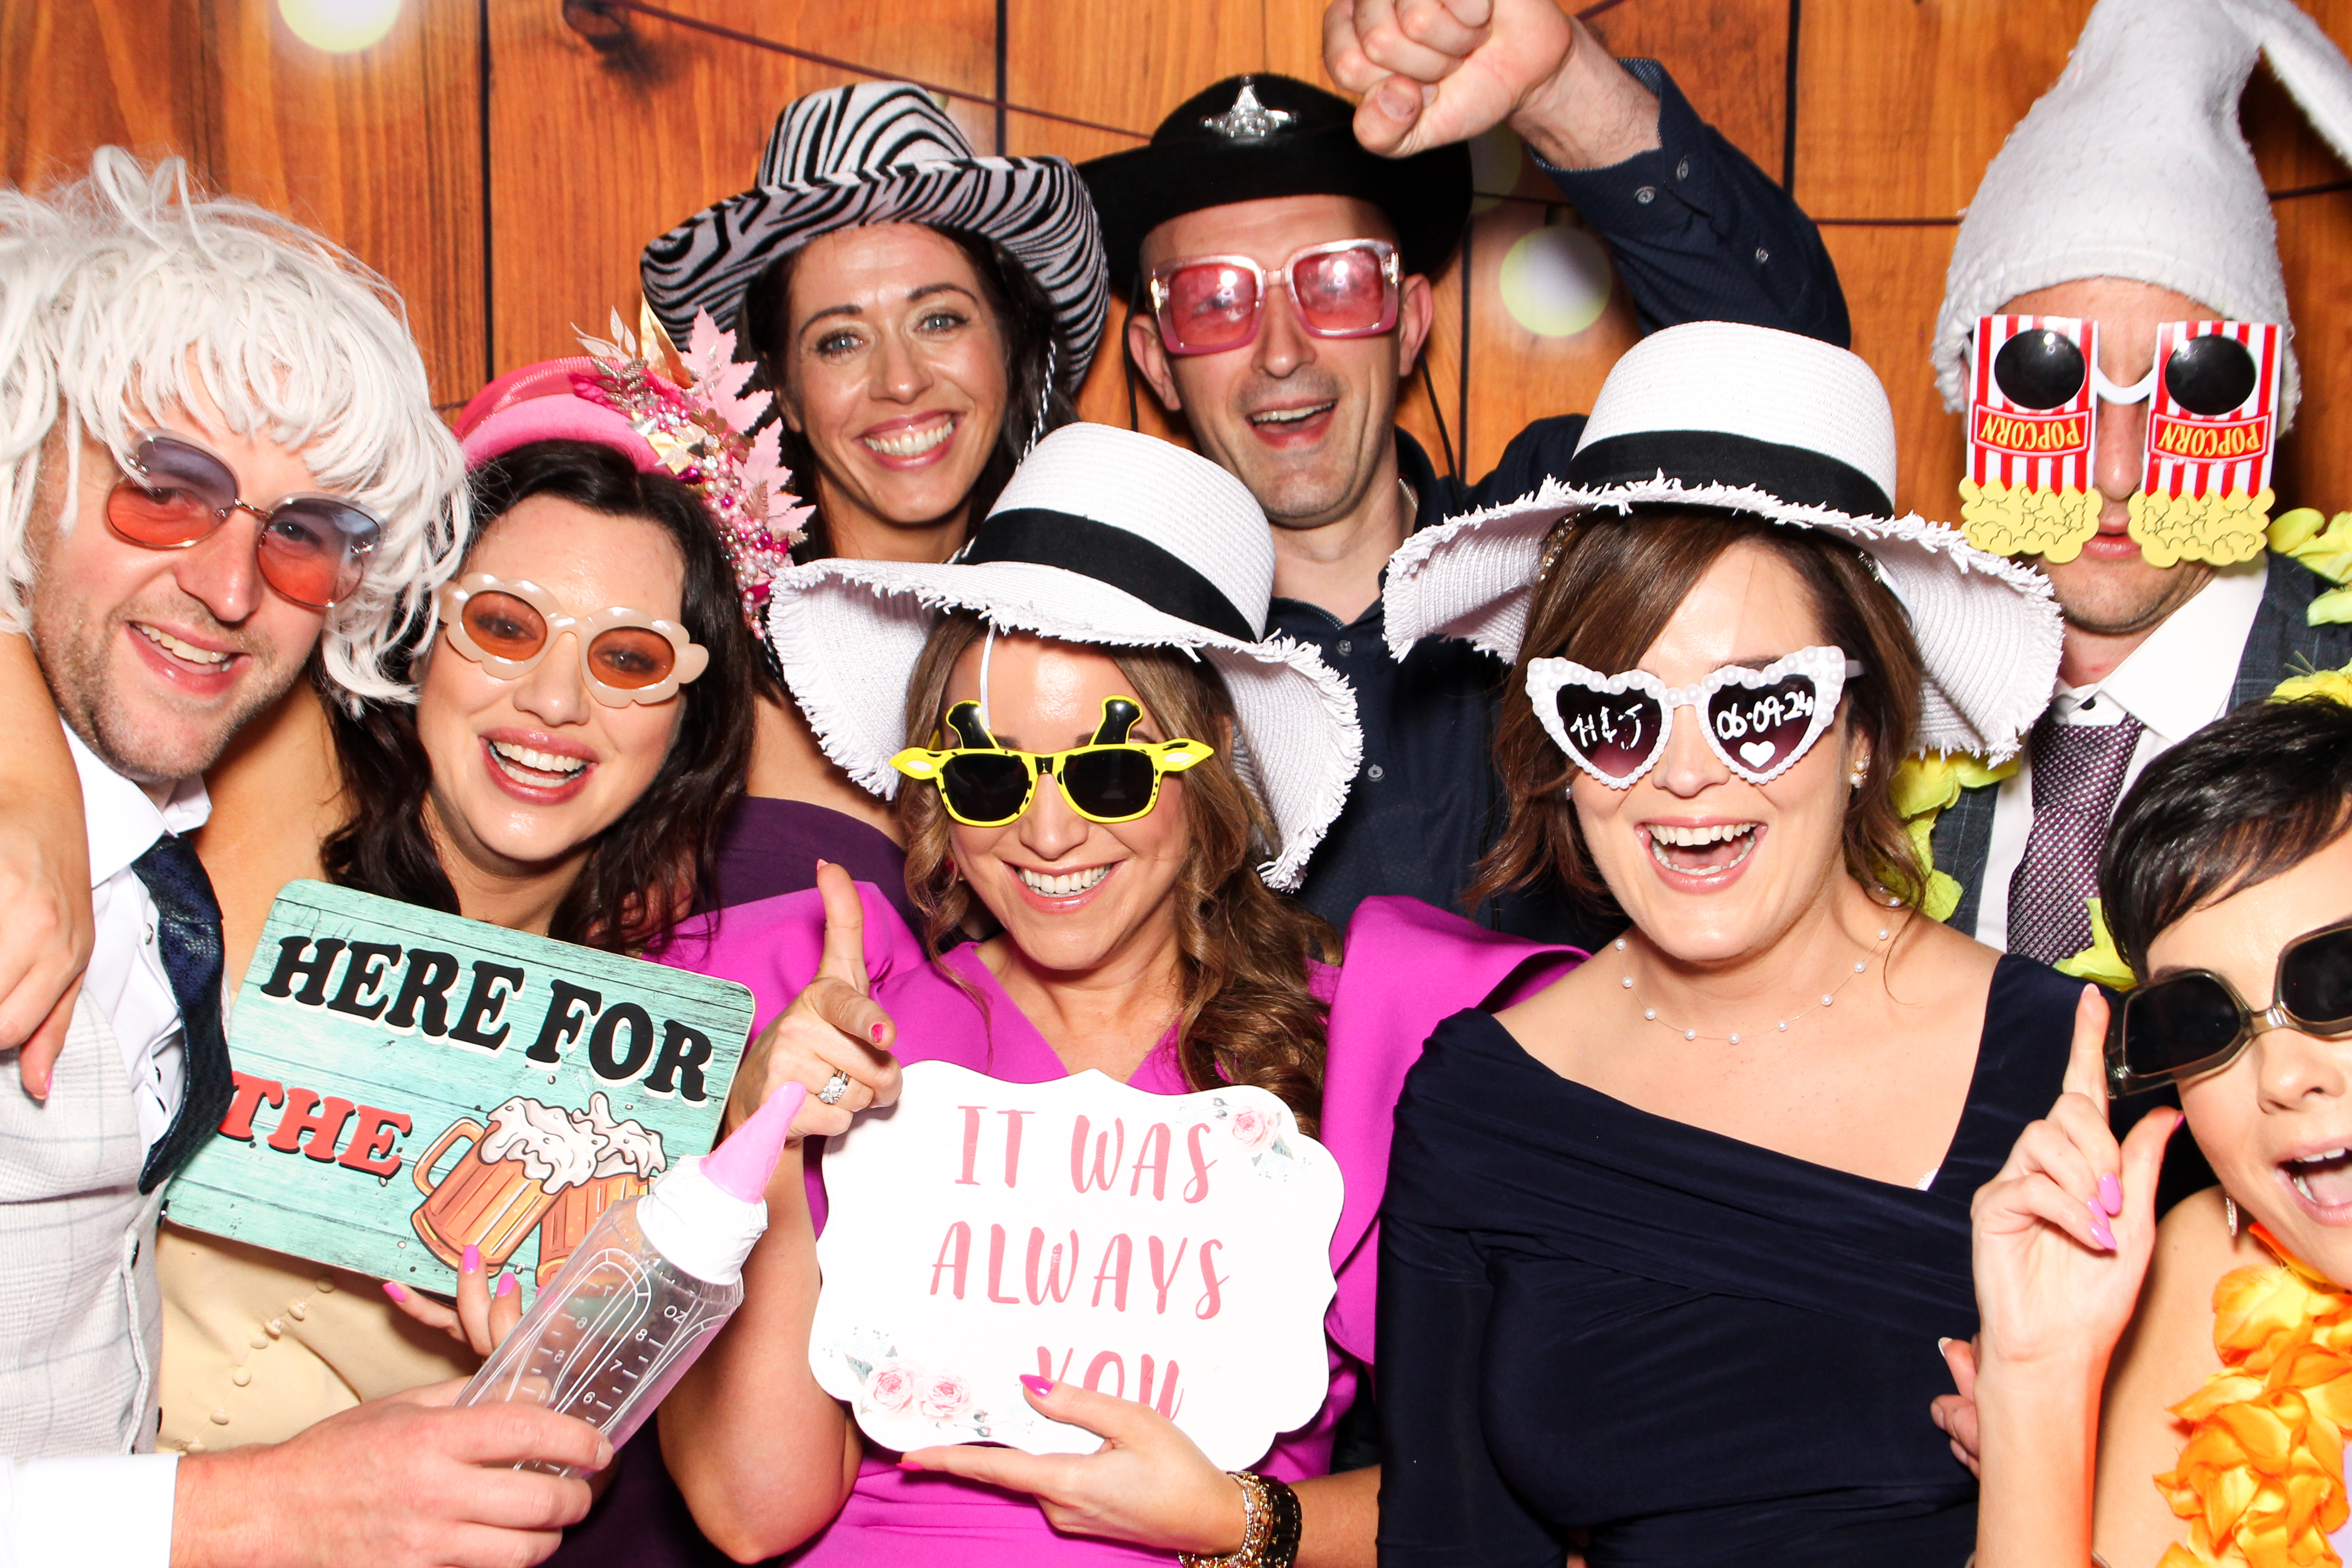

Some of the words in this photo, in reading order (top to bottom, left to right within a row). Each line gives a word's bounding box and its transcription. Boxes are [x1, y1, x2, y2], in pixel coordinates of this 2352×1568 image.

[1979, 412, 2082, 450] POPCORN
[2157, 420, 2261, 457] POPCORN
[260, 935, 526, 1054] HERE
[526, 979, 714, 1104] FOR
[217, 1070, 412, 1179] THE
[955, 1105, 1036, 1189] IT
[1070, 1114, 1218, 1204] WAS
[929, 1220, 1230, 1321] ALWAYS
[635, 1328, 649, 1342] 8
[609, 1358, 624, 1373] 7
[582, 1391, 596, 1404] 6
